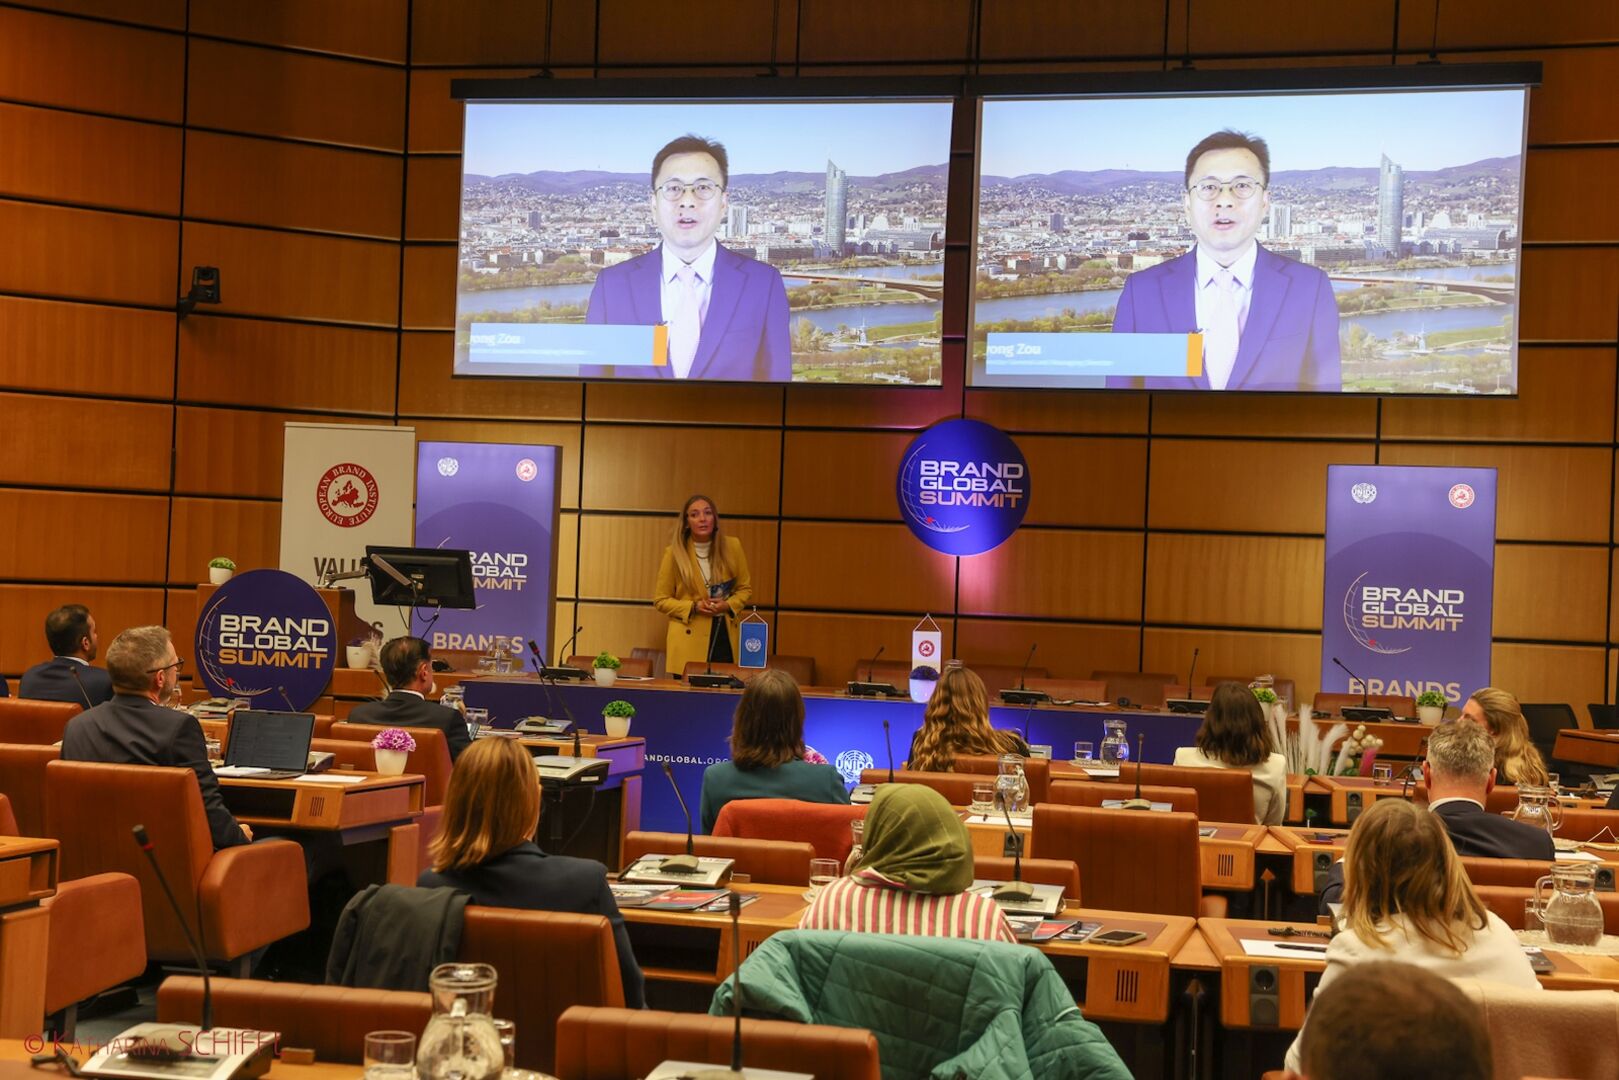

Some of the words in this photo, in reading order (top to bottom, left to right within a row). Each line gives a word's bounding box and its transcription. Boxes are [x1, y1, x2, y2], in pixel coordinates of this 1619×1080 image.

[1016, 343, 1042, 355] Zou
[920, 460, 1024, 479] BRAND
[919, 477, 1023, 493] GLOBAL
[319, 477, 344, 525] EUROPEAN
[332, 465, 366, 478] BRAND
[349, 480, 377, 525] INSTITUTE
[919, 490, 1023, 508] SUMMIT
[469, 551, 528, 567] RAND
[472, 565, 527, 578] OBAL
[473, 577, 527, 591] MMIT
[1362, 586, 1464, 604] BRAND
[1362, 601, 1464, 617] GLOBAL
[220, 614, 329, 637] BRAND
[1361, 614, 1463, 632] SUMMIT
[219, 632, 329, 652] GLOBAL
[218, 648, 328, 669] SUMMIT
[836, 759, 874, 770] UNIDO
